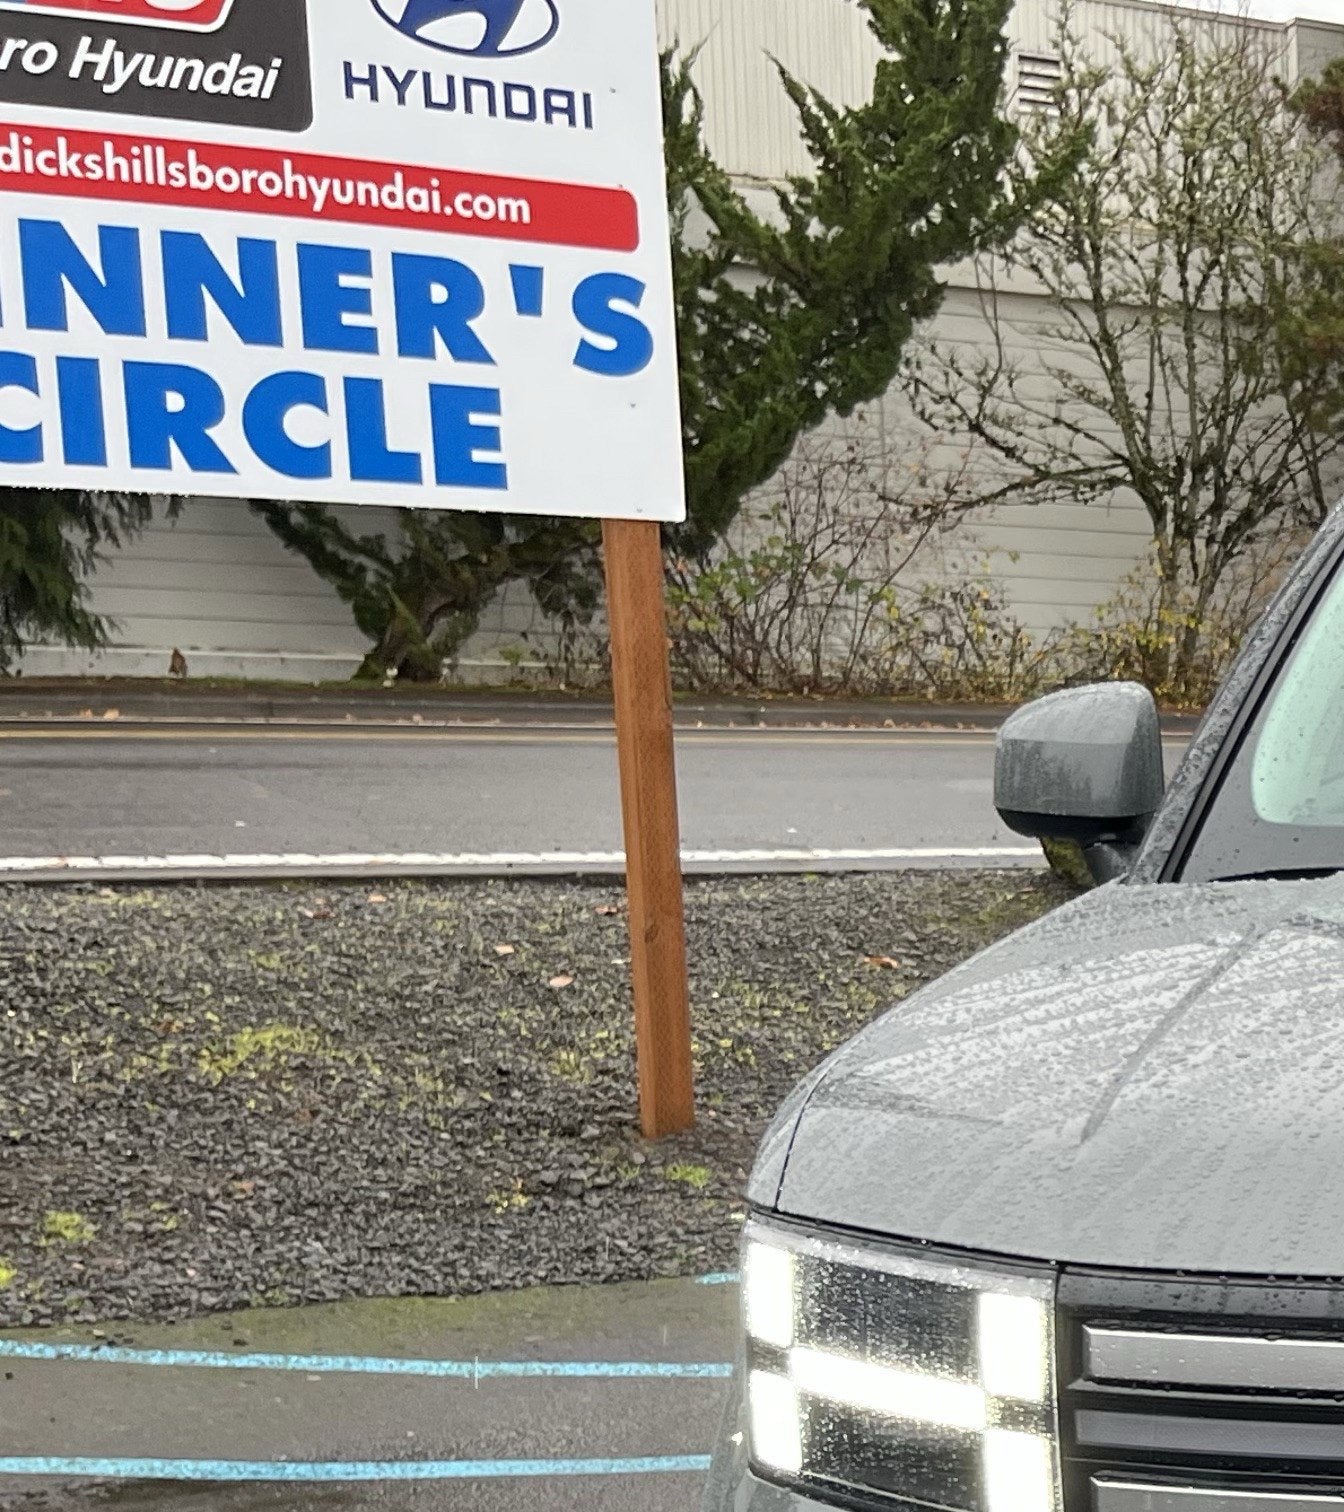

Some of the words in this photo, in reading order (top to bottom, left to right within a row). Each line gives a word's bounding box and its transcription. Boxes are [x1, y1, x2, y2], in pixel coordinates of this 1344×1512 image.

[68, 35, 282, 99] Hyundai
[343, 60, 594, 130] HYUNDAI
[0, 131, 531, 225] dickshillsborohyundai.com
[0, 218, 654, 377] NNER'S
